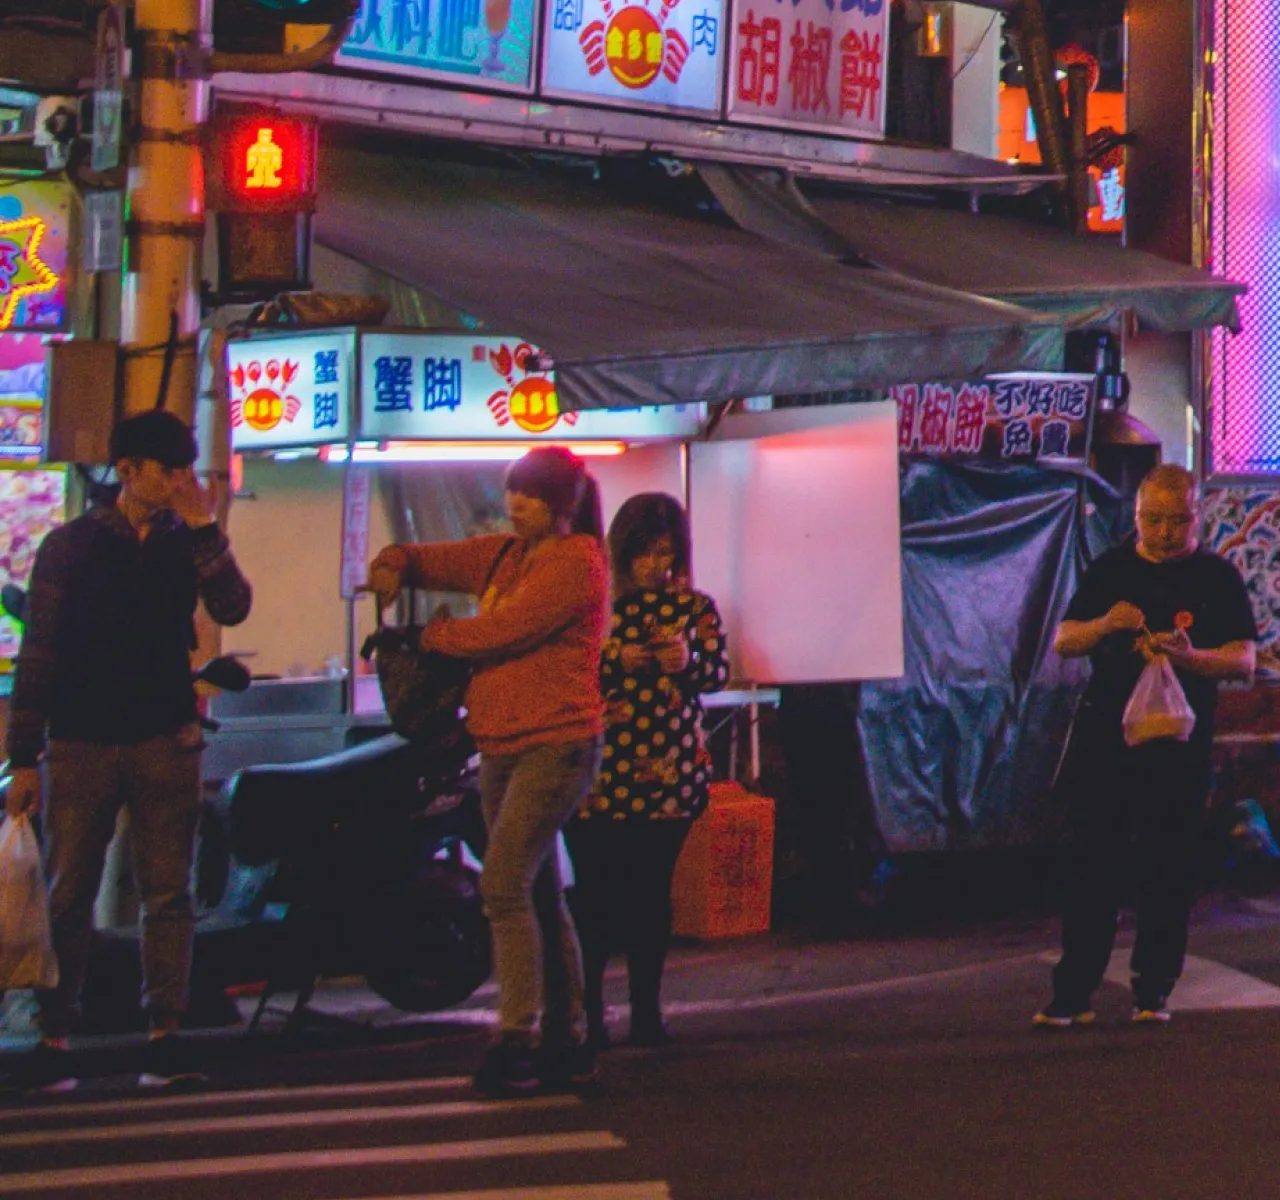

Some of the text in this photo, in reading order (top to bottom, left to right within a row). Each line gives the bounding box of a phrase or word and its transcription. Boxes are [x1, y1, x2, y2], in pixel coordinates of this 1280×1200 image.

[738, 9, 882, 123] 胡椒餅
[996, 380, 1088, 420] 不好吃
